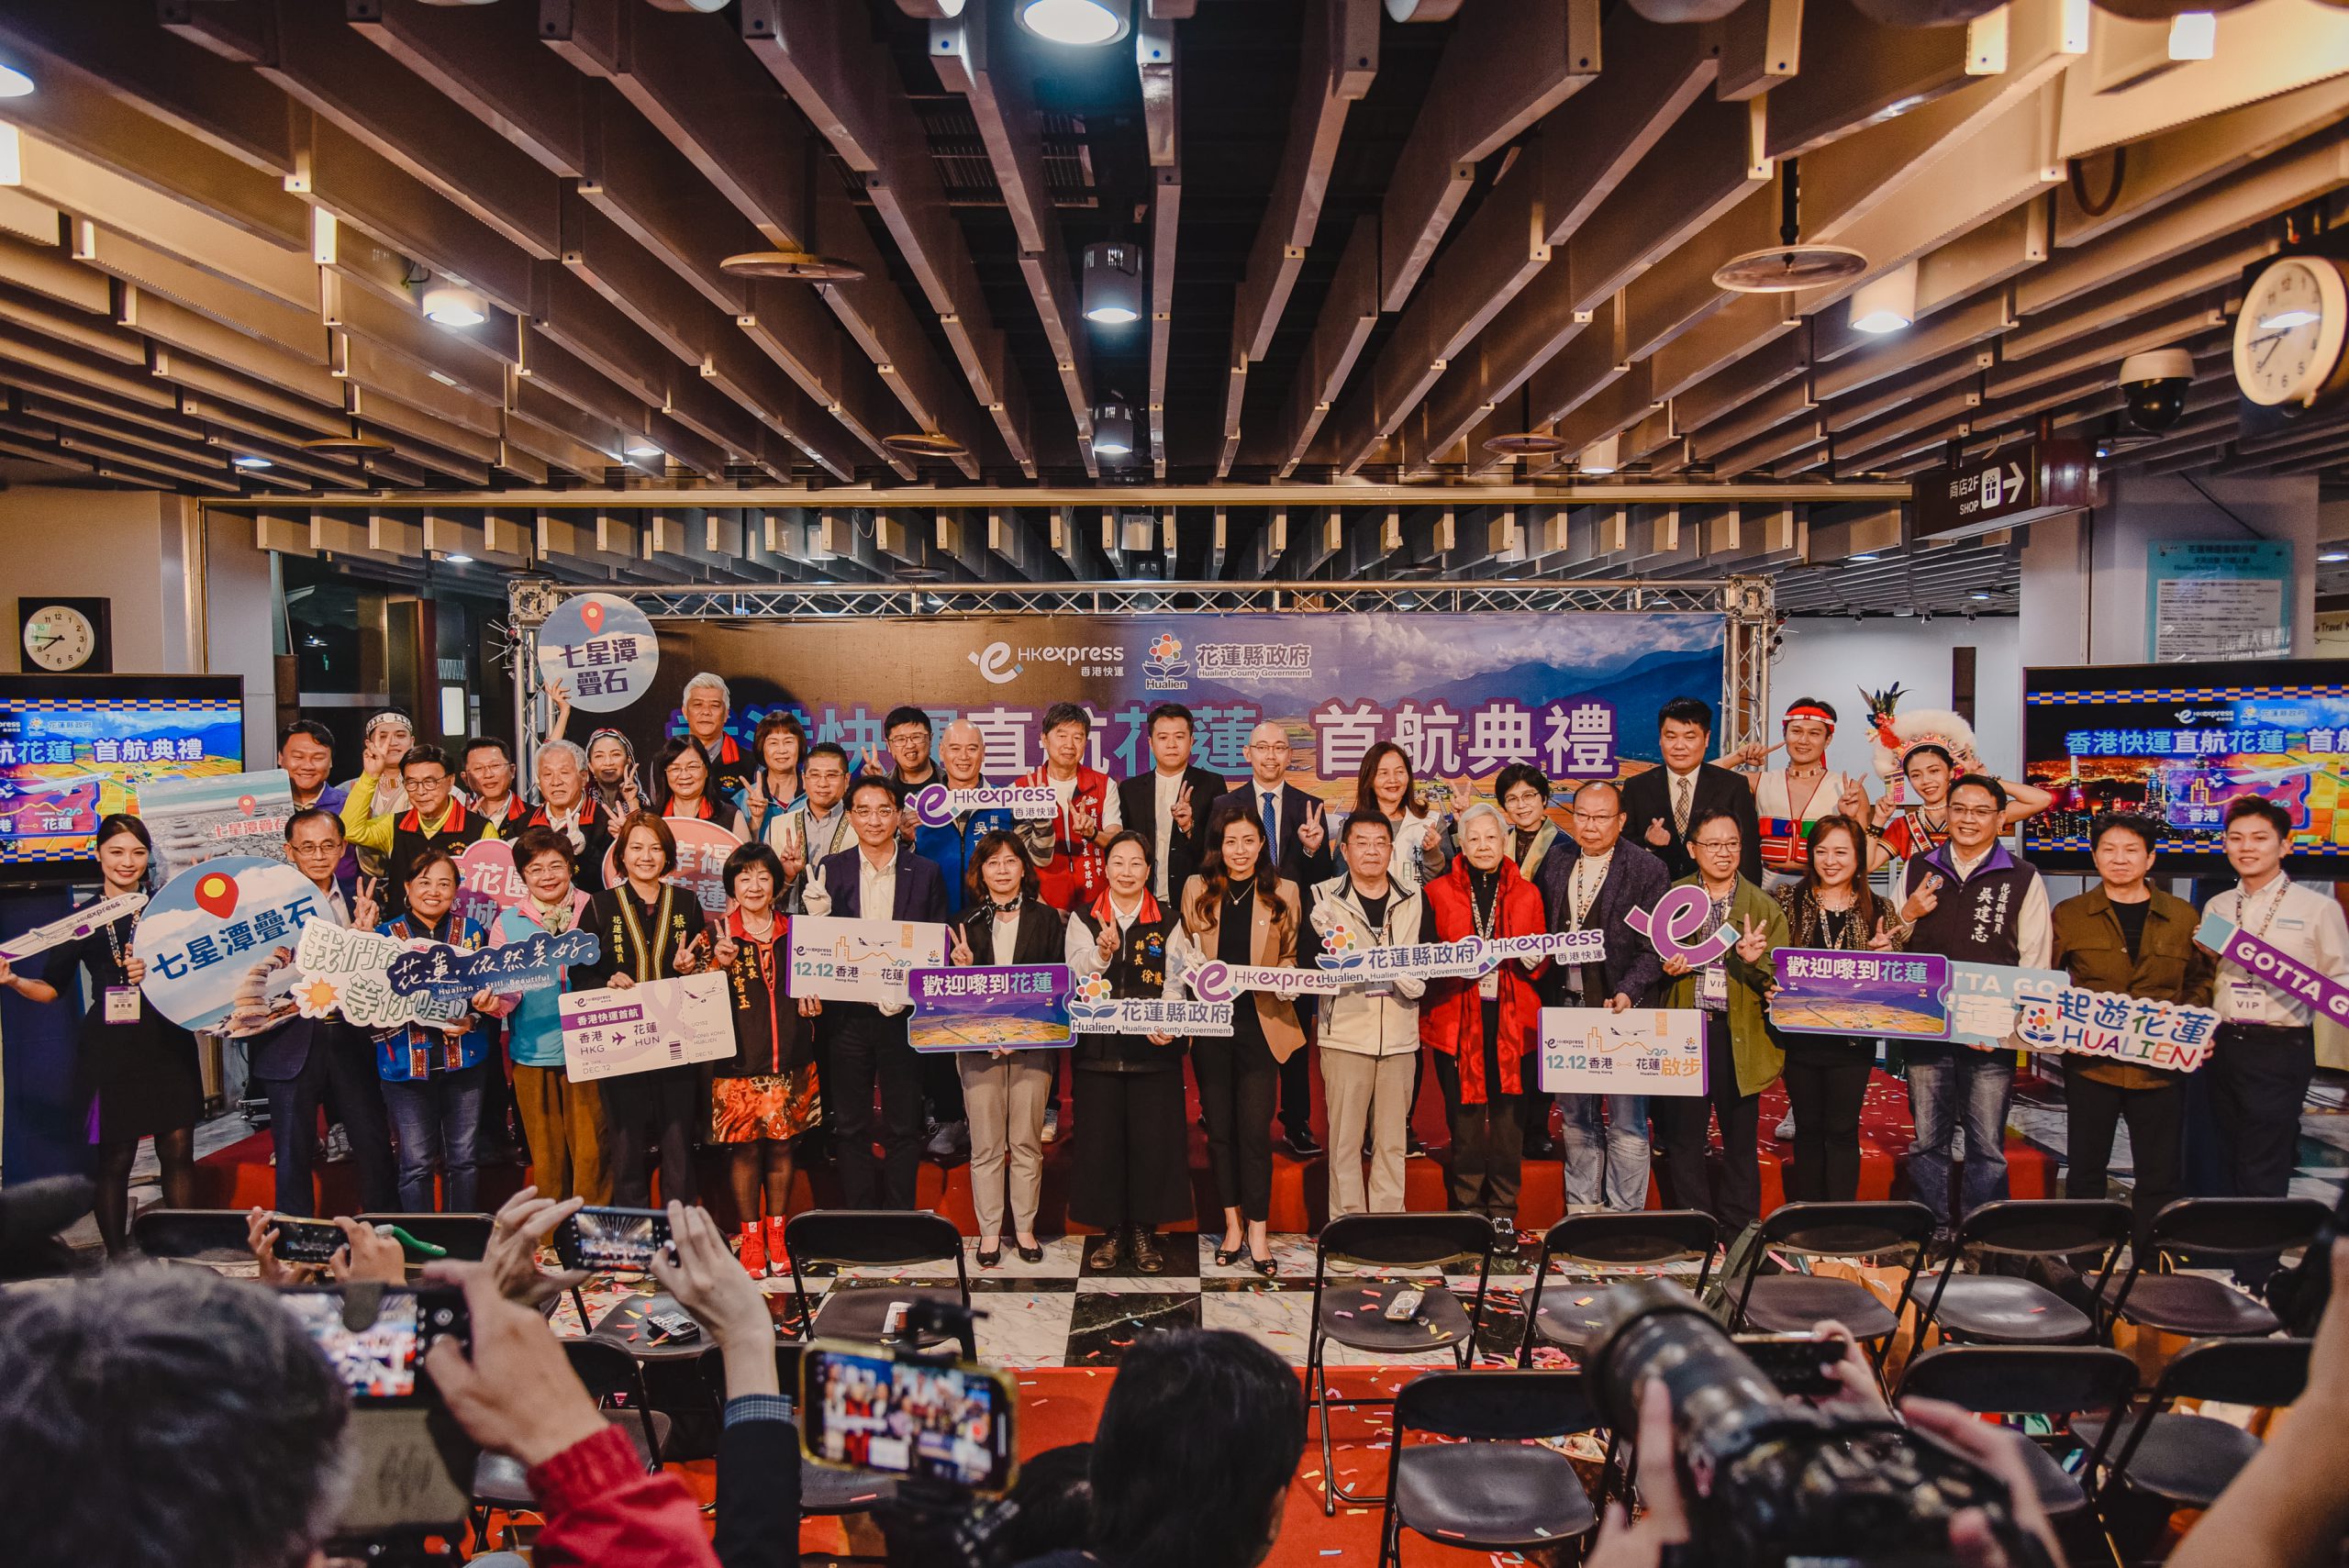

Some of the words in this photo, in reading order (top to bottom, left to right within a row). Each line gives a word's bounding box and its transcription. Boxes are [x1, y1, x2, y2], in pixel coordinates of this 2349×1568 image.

[1949, 475, 1979, 499] 商店2F
[1959, 499, 1979, 516] SHOP
[559, 638, 639, 669] 七星潭
[1018, 646, 1124, 666] HKexpress
[1196, 644, 1311, 667] 花蓮縣政府
[577, 668, 629, 696] 疊石
[1080, 666, 1125, 677] 香港快運
[1197, 669, 1230, 679] Hualien
[1230, 669, 1260, 680] County
[1261, 669, 1312, 679] Government
[1145, 679, 1187, 690] Hualien
[1315, 704, 1613, 774] 首航典禮
[2066, 729, 2285, 753] 香港快運直航花蓮
[94, 739, 205, 763] 首航典禮
[953, 787, 1056, 806] HKexpress
[1014, 807, 1056, 817] 香港快運
[2188, 809, 2219, 823] 香港
[42, 817, 73, 831] 花蓮
[215, 817, 288, 839] 七星潭疊石
[1971, 886, 1994, 943] 吳建志
[150, 895, 318, 980] 七星潭疊石
[612, 916, 625, 963] 花蓮縣議員
[1490, 929, 1602, 958] HKexpress
[1367, 944, 1475, 970] 花蓮縣政府
[1557, 949, 1604, 964] 香港快運
[509, 973, 550, 985] Beautiful
[794, 962, 834, 978] 12.12
[835, 965, 859, 978] 香港
[881, 968, 904, 981] 花蓮
[1321, 972, 1364, 984] Hualien
[1370, 971, 1399, 980] Hualien
[1401, 970, 1429, 979] ounty
[1430, 966, 1476, 977] Government
[1786, 955, 1928, 984] 歡迎嚟到花蓮
[2236, 941, 2321, 1002] GOTTA
[922, 972, 1053, 997] 歡迎嚟到花蓮
[1121, 1001, 1232, 1025] 花蓮縣政府
[2236, 1000, 2260, 1009] VIP
[576, 1007, 639, 1027] 香港快運首航
[1072, 1021, 1116, 1033] Hualien
[2020, 990, 2215, 1045] 一起遊花蓮
[579, 1030, 603, 1044] 香港
[634, 1022, 658, 1036] 花蓮
[1122, 1025, 1152, 1033] Hualien
[1153, 1026, 1183, 1035] County
[1183, 1025, 1231, 1034] Government
[580, 1045, 605, 1056] HKG
[635, 1036, 661, 1047] HUN
[2063, 1025, 2198, 1068] HUALIEN
[583, 1066, 597, 1074] DEC
[602, 1063, 611, 1072] 12
[1545, 1054, 1586, 1070] 12.12
[1588, 1057, 1613, 1070] 香港
[1636, 1058, 1660, 1071] 花蓮
[1662, 1057, 1703, 1077] 啟步
